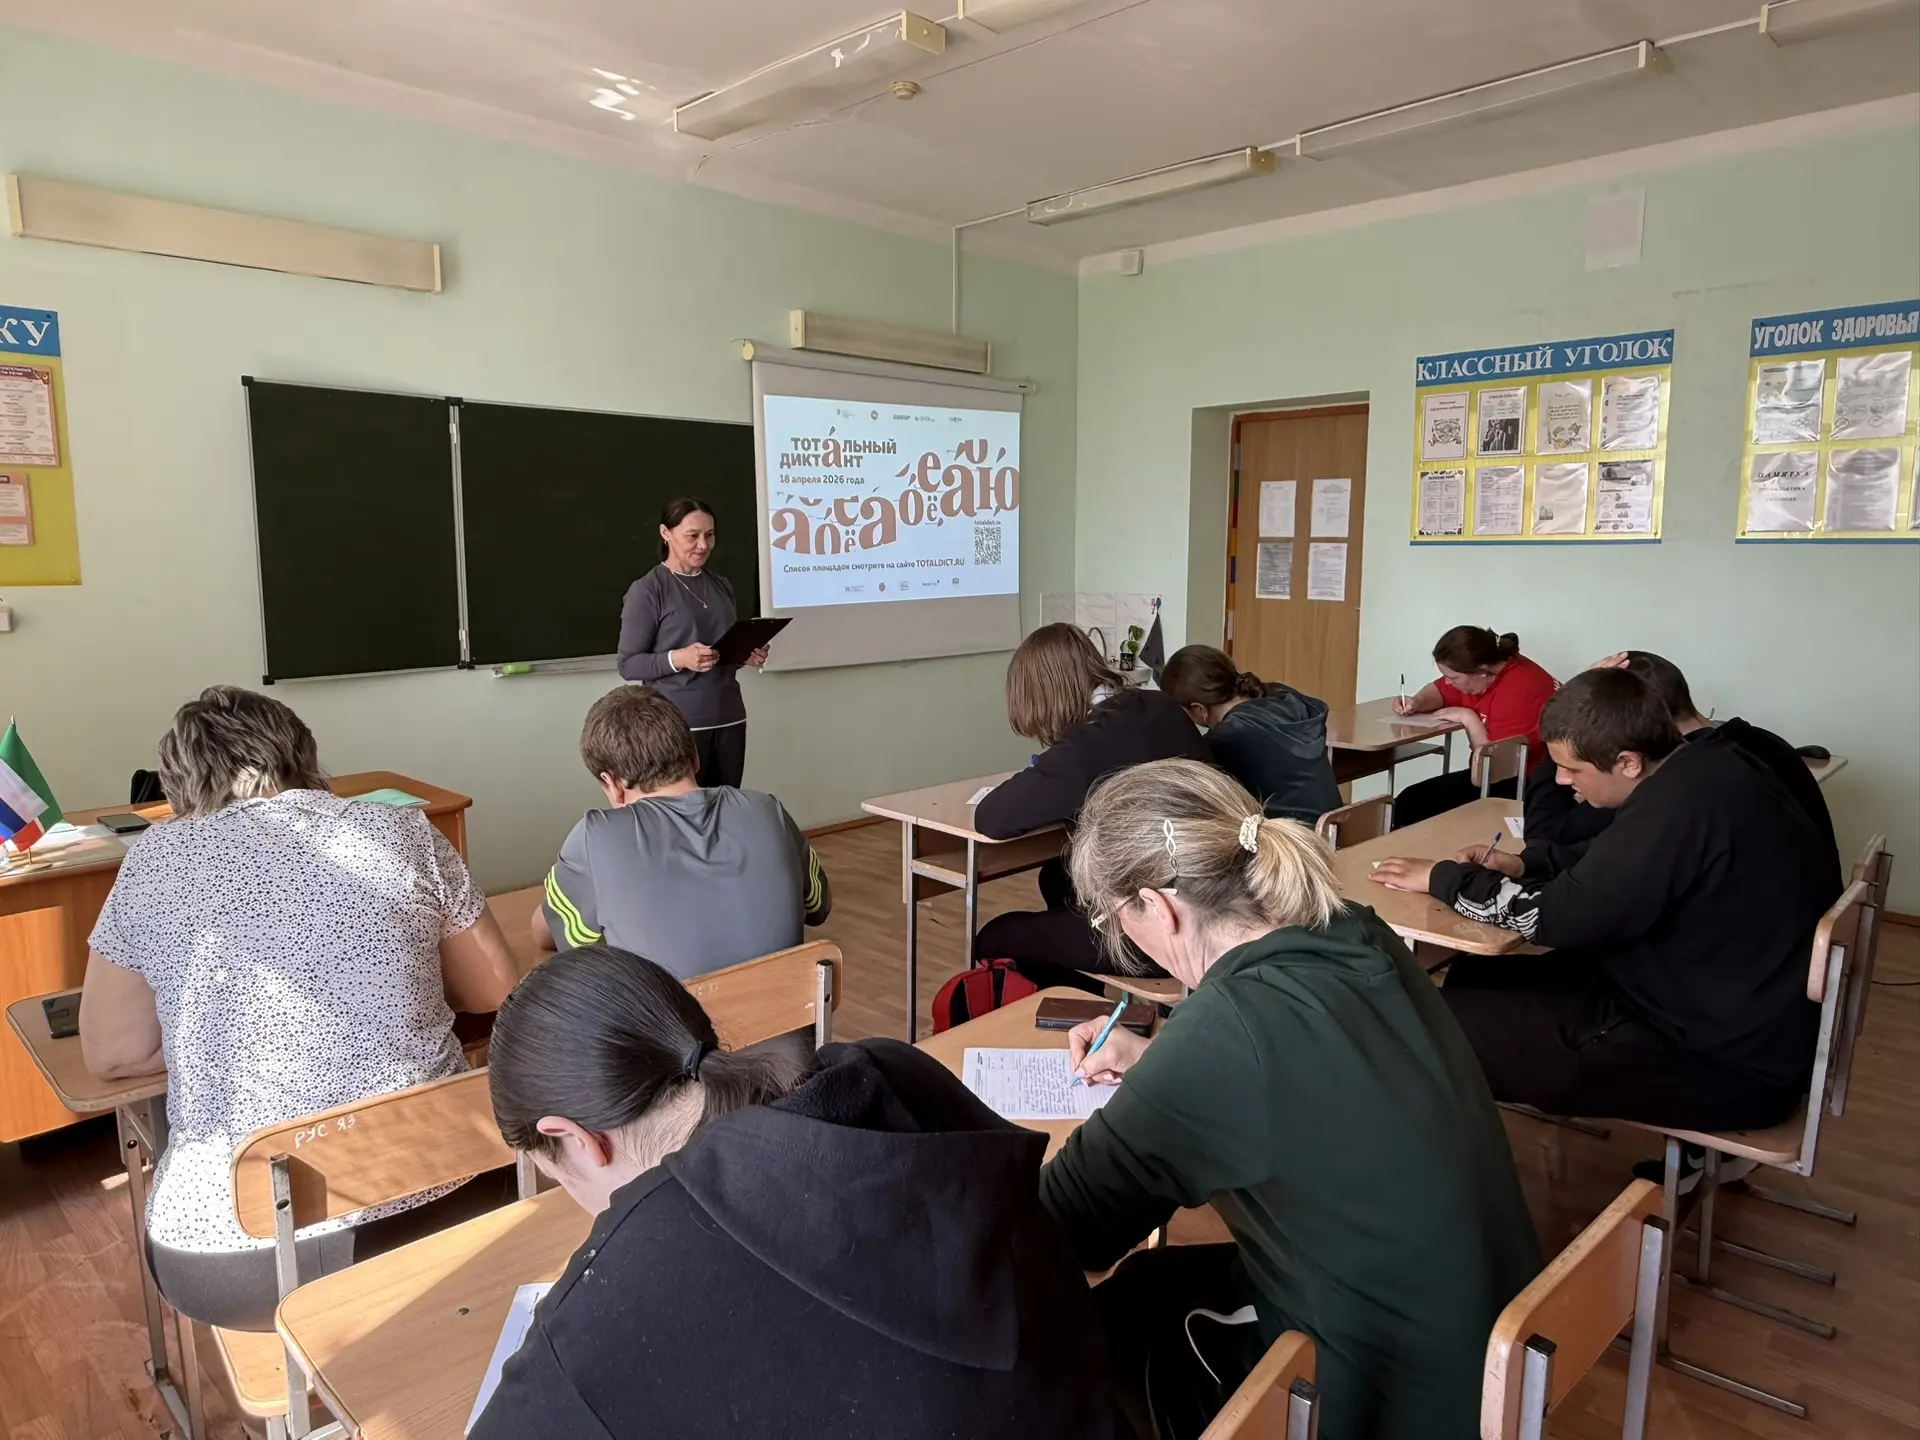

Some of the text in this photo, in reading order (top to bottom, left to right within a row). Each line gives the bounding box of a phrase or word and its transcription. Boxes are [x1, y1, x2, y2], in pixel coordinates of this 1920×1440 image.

[1753, 311, 1920, 350] УГОЛОК ЗДОРОВЬЯ
[1416, 337, 1673, 382] КЛАССНЫЙ УГОЛОК
[780, 474, 865, 485] 18 апреля 2026 года
[783, 564, 811, 573] Список
[812, 564, 850, 572] площадок
[851, 562, 885, 571] смотрите
[896, 560, 915, 568] сайте
[915, 558, 965, 568] TOTALDICT.RU
[294, 1122, 329, 1150] РУС
